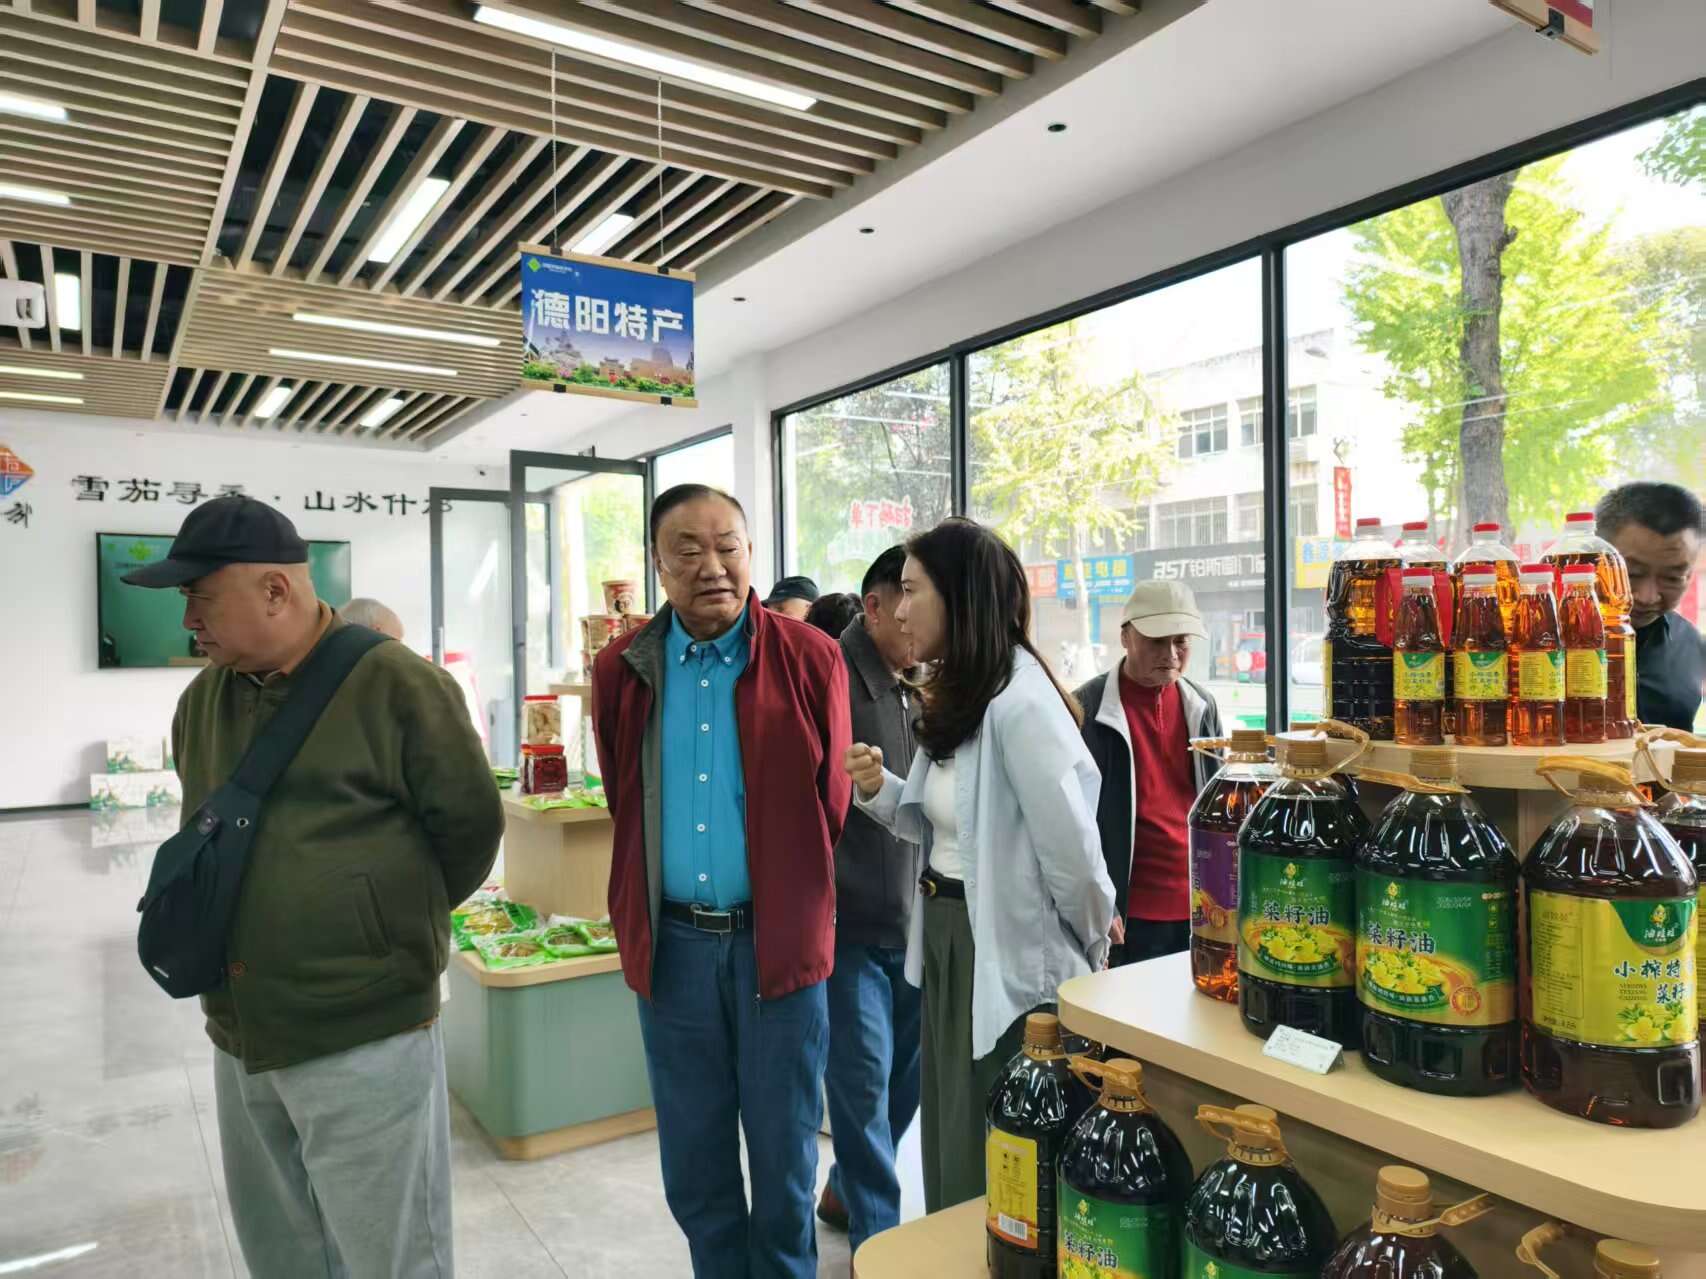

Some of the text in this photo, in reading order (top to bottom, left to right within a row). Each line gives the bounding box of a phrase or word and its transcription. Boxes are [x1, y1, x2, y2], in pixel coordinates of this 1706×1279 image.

[531, 289, 683, 343] 德阳特产
[1263, 899, 1330, 927] 菜籽油
[1367, 921, 1437, 954] 菜籽油
[1614, 959, 1694, 980] 小榨特
[1064, 1231, 1119, 1269] 菜籽油
